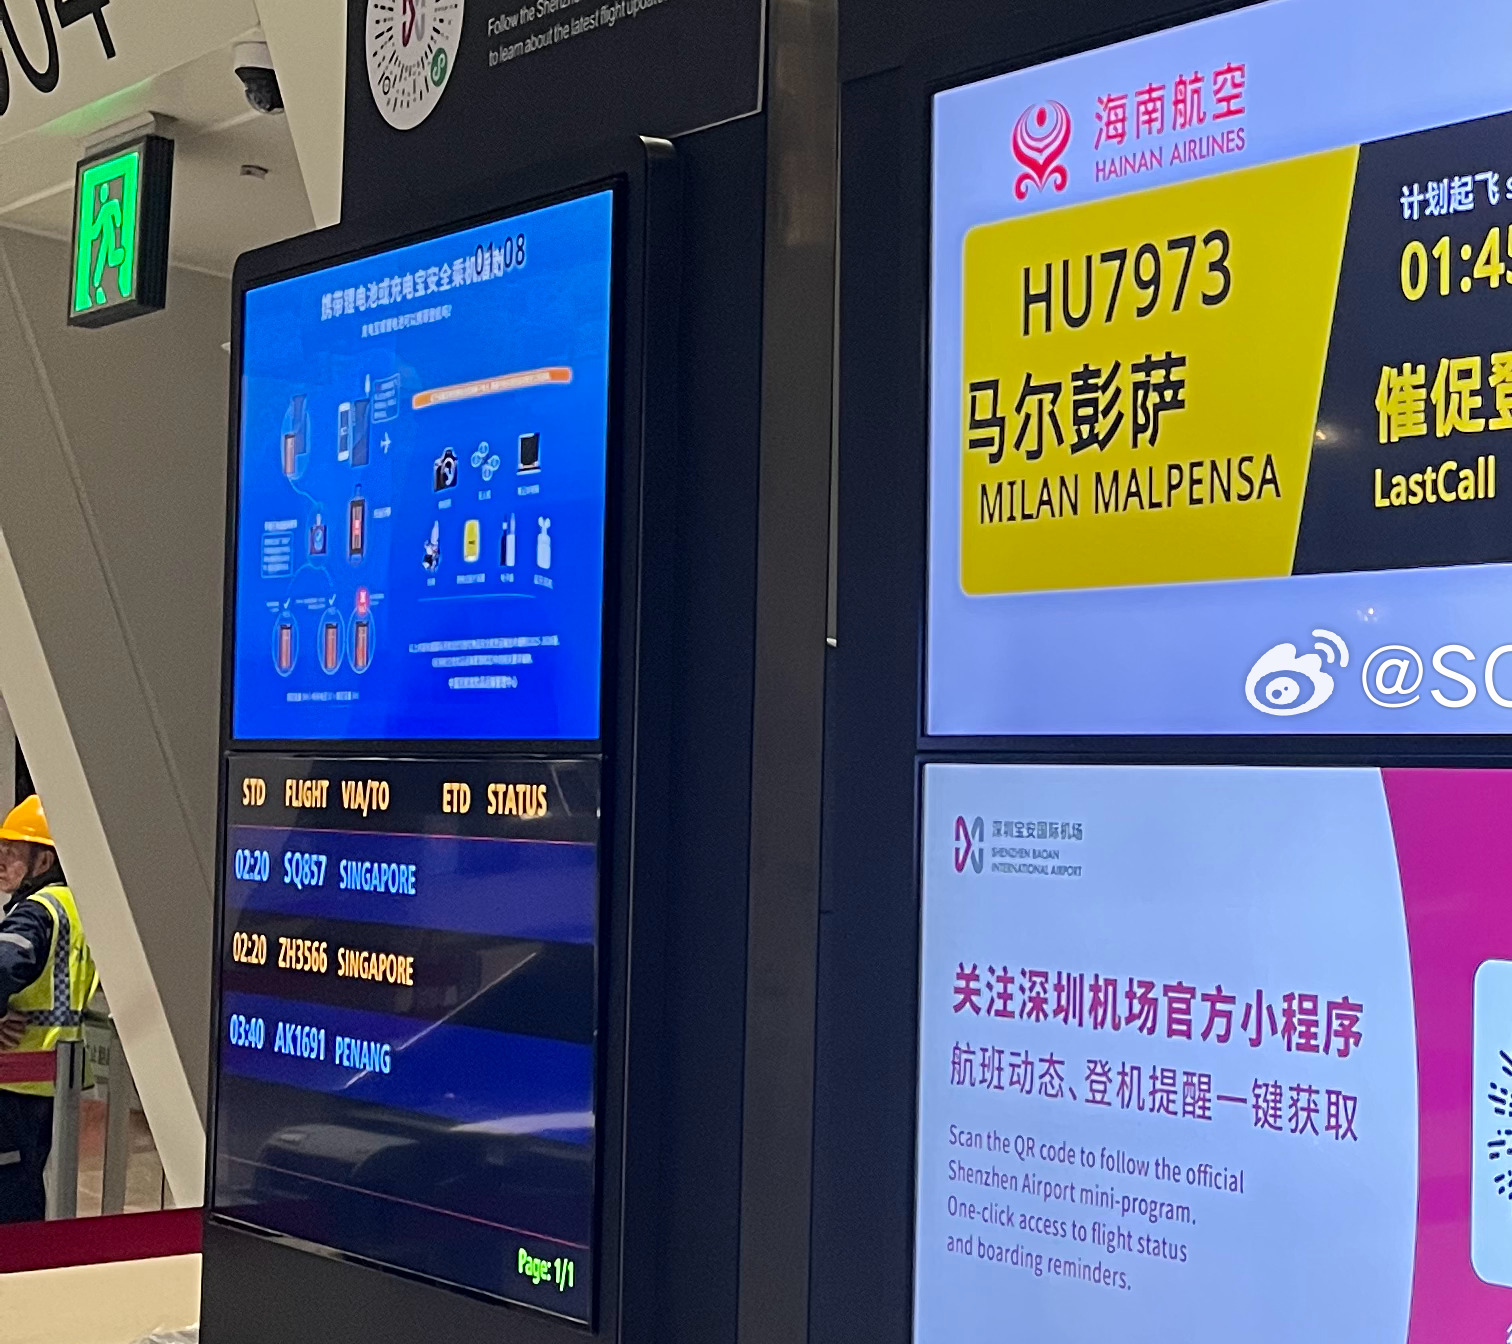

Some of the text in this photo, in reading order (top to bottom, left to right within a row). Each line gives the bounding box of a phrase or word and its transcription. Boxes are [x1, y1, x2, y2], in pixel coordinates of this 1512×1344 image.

[487, 12, 519, 37] Follow
[519, 5, 535, 26] the
[488, 50, 499, 67] to
[499, 40, 523, 63] learn
[524, 29, 553, 54] about
[553, 22, 570, 43] the
[570, 9, 600, 37] latest
[600, 0, 625, 28] flight
[1093, 62, 1247, 150] 海南航空
[1094, 127, 1247, 182] HAINAN AIRLINES
[1400, 171, 1500, 223] 计划起飞
[475, 233, 525, 275] 01:08
[1021, 227, 1233, 337] HU7973
[967, 351, 1187, 465] 马尔彭萨
[979, 453, 1282, 525] MILAN MALPENSA
[1373, 454, 1497, 509] LastCall
[242, 777, 548, 817] STD FLIGHT VIA/TO ETD STATUS
[991, 820, 1083, 840] 深圳宝安国际机场
[991, 847, 1030, 859] SHENZHEN
[235, 849, 416, 896] 02:20 SQ857 SINGAPORE
[991, 862, 1082, 877] INTERNATIONAL AIRPORT
[233, 932, 414, 986] 02:20 ZH3566 SINGAPORE
[953, 961, 1364, 1060] 关注深圳机场官方小程序
[229, 1014, 392, 1074] 03:40 AK1691 PENANG
[949, 1041, 1359, 1143] 航班动态、登机提醒一键获取
[949, 1124, 1244, 1194] Scan the QR code to follow the official
[948, 1159, 1196, 1225] Shenzhen Airport mini-program.
[947, 1195, 1187, 1263] One-click access to flight status
[518, 1248, 575, 1291] Page: 1/1
[947, 1233, 1132, 1291] and boarding reminders.
